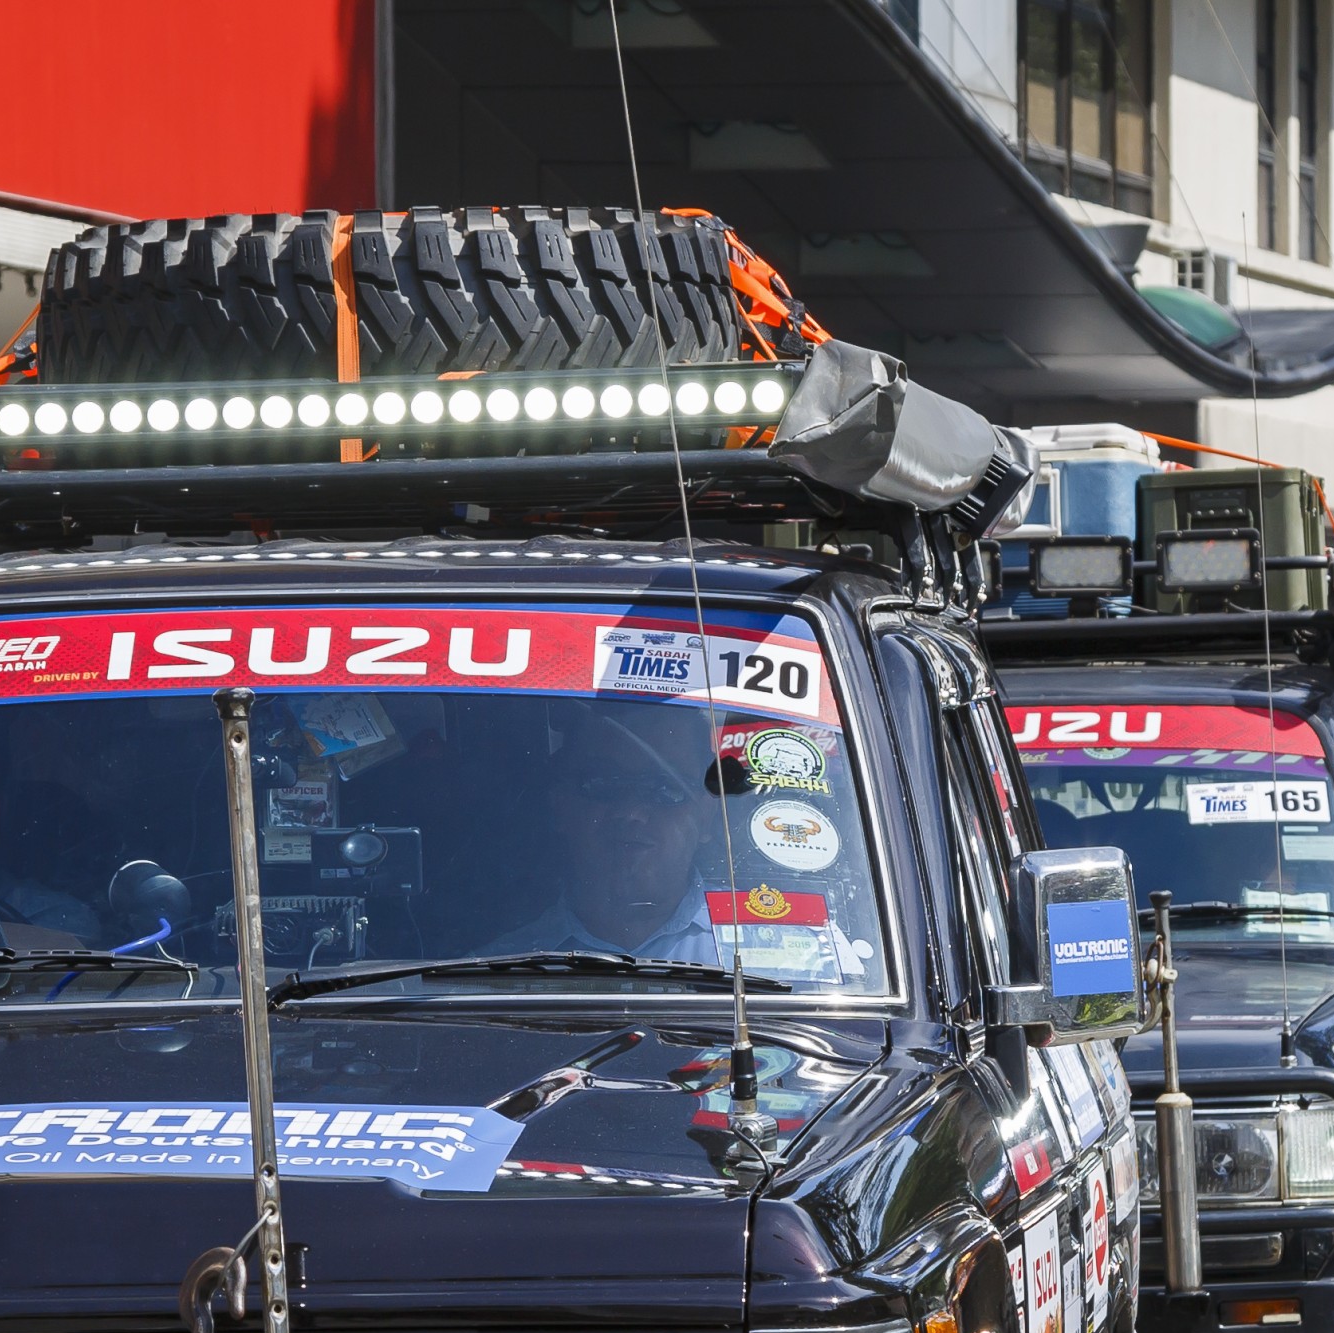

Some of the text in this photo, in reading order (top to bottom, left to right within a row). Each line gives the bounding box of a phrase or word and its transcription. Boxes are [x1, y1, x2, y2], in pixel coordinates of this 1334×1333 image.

[107, 627, 531, 680] ISUZU
[646, 649, 691, 660] SABAH
[614, 646, 691, 680] TIMES
[33, 671, 99, 683] DRIVEN BY
[719, 651, 809, 699] 120
[614, 682, 686, 693] OFFICIAL MEDIA
[282, 786, 323, 795] OFFICER
[750, 773, 830, 795] SABAH
[1200, 795, 1247, 813] TIMES
[1265, 790, 1321, 812] 165
[767, 842, 828, 851] PENAMPANG
[1054, 938, 1128, 958] VOLTRONIC
[5, 1151, 58, 1165] Oil
[75, 1152, 193, 1164] Made
[207, 1152, 240, 1165] in
